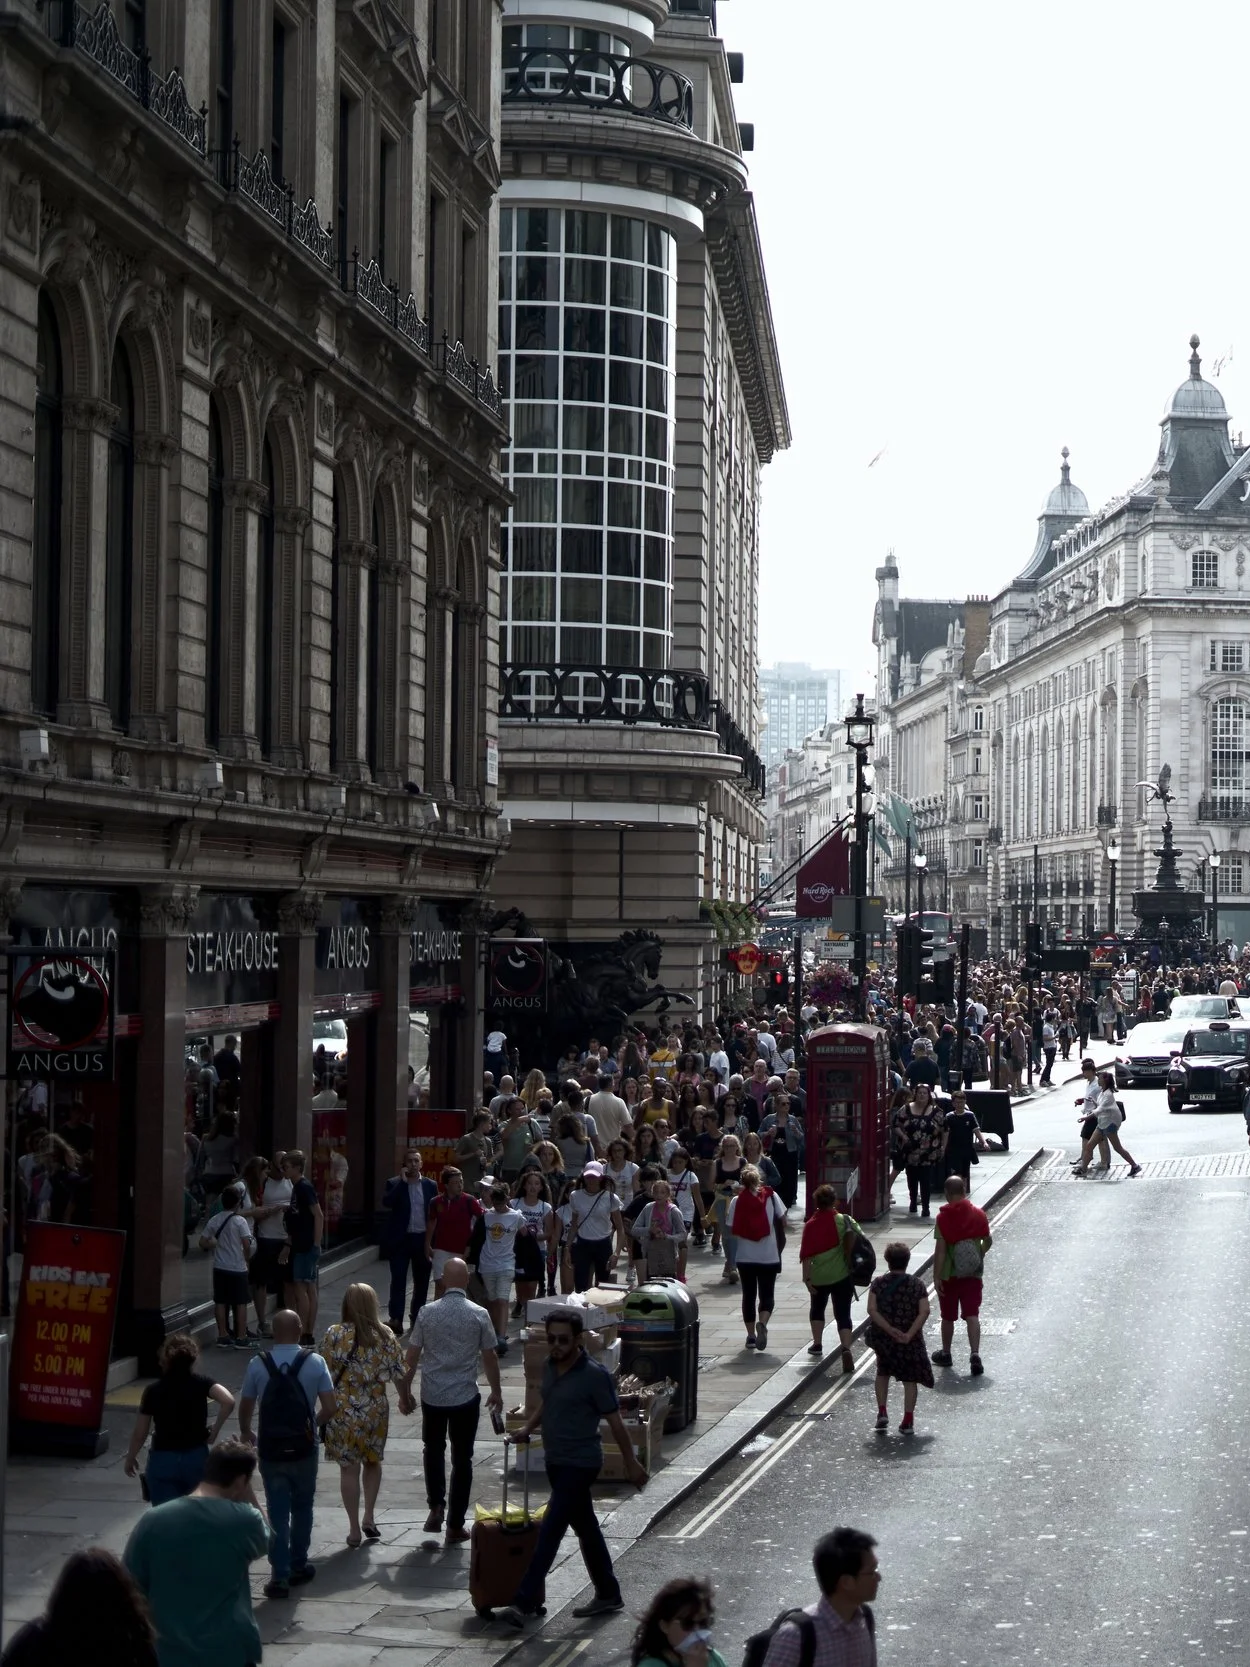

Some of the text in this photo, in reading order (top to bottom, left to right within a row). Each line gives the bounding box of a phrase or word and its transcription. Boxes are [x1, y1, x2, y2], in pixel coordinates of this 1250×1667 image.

[803, 886, 819, 895] Hard
[820, 885, 835, 895] Rock
[187, 932, 279, 973] STEAKHOUSE
[327, 926, 370, 969] ANGUS
[493, 997, 541, 1007] ANGUS
[17, 1053, 104, 1072] ANGUS
[409, 1136, 435, 1147] KIDS
[29, 1265, 111, 1287] KIDS EAT
[26, 1280, 112, 1314] FREE
[36, 1320, 92, 1344] 12.00 PM
[33, 1353, 85, 1377] 5.00 PM
